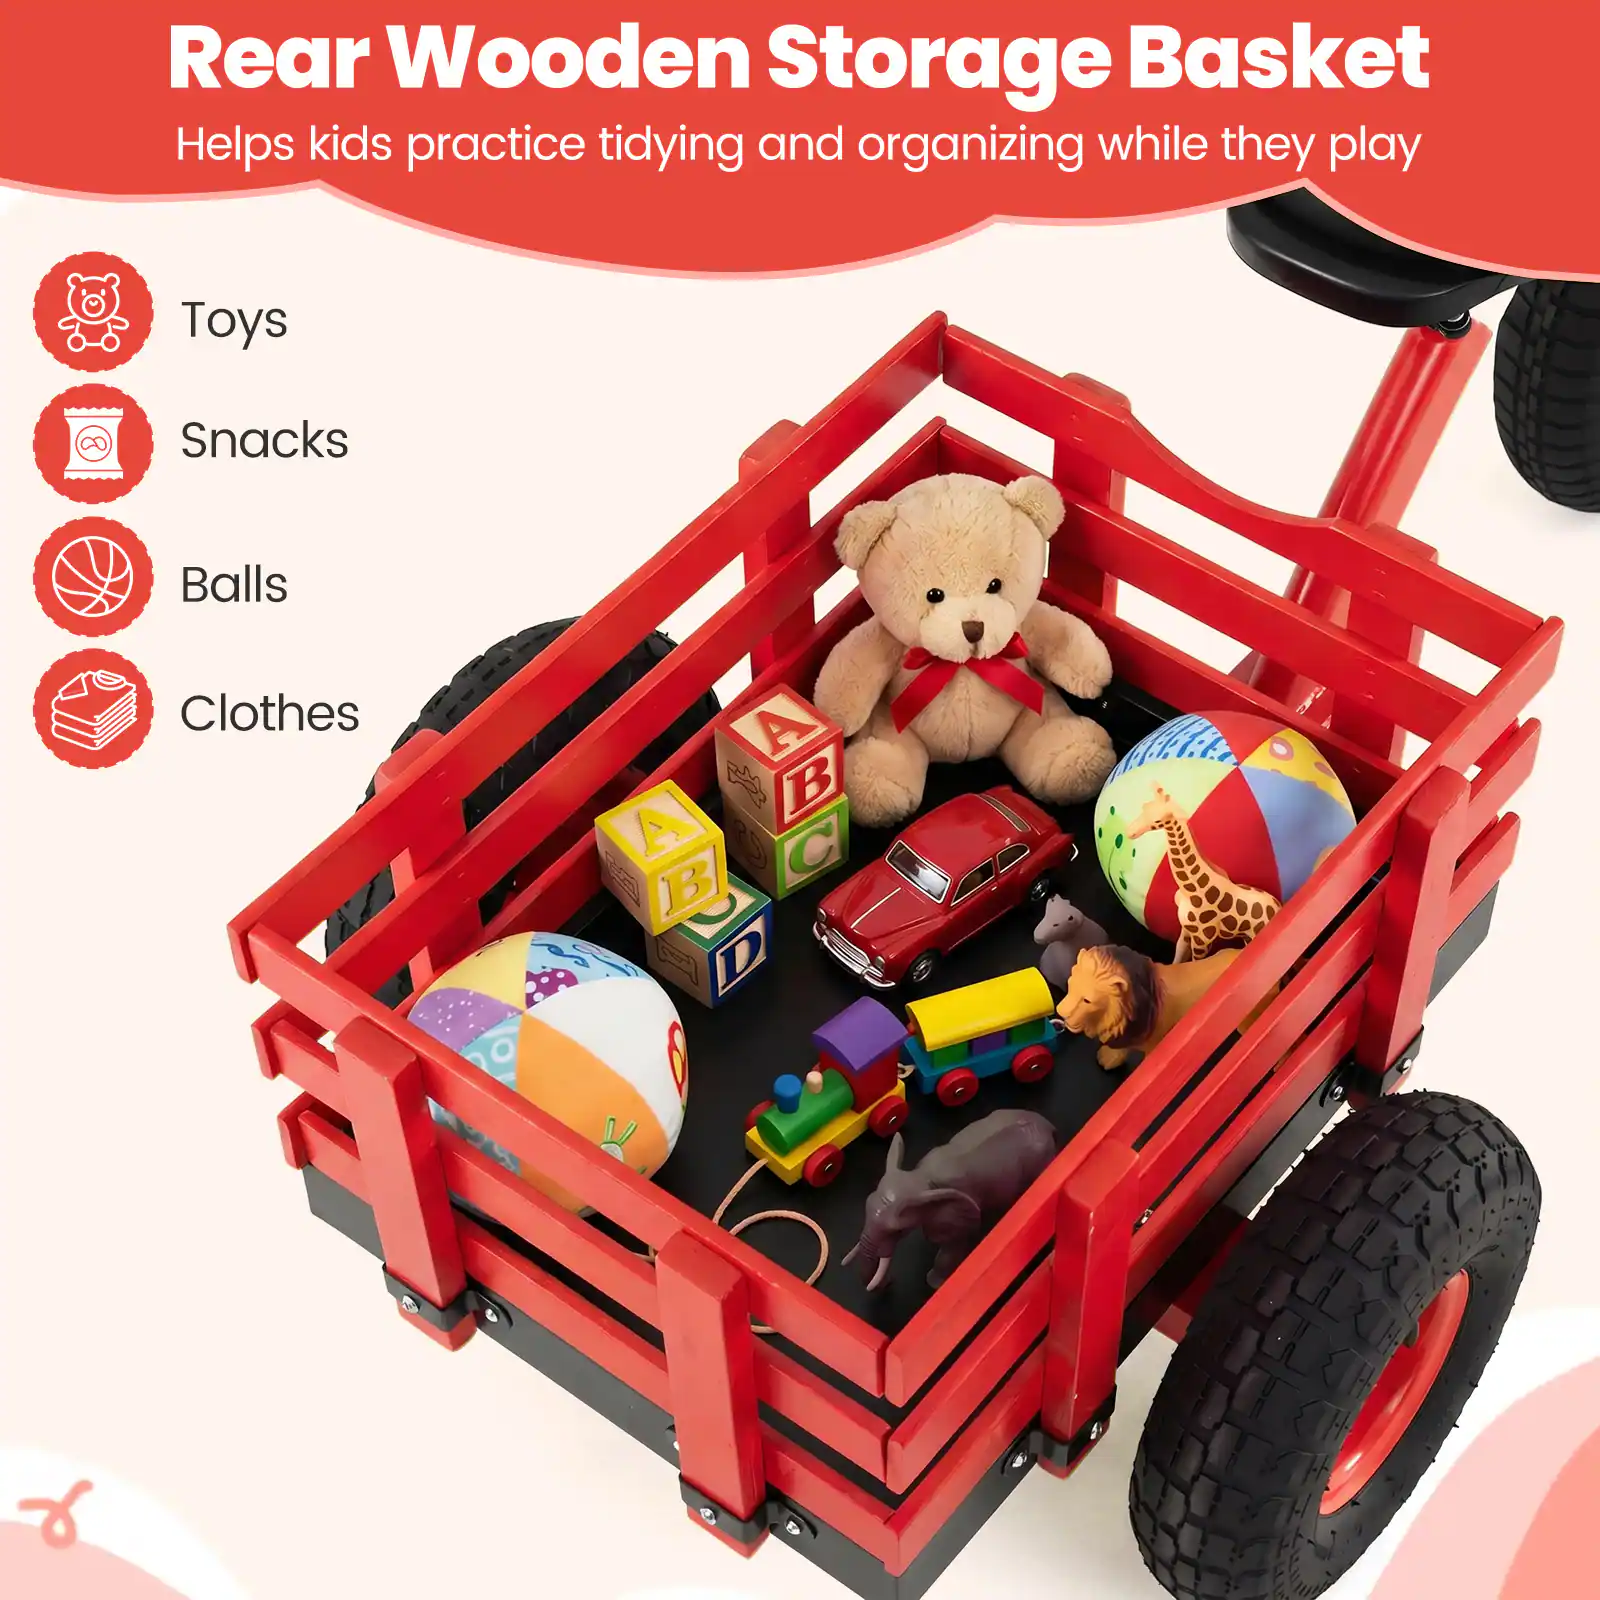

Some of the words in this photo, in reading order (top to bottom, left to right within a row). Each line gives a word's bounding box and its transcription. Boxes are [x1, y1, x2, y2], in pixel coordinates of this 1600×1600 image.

[755, 710, 819, 757] A
[787, 756, 832, 816] B
[637, 807, 698, 858] A
[789, 820, 834, 875] C
[662, 857, 709, 918] B
[720, 930, 762, 990] D
